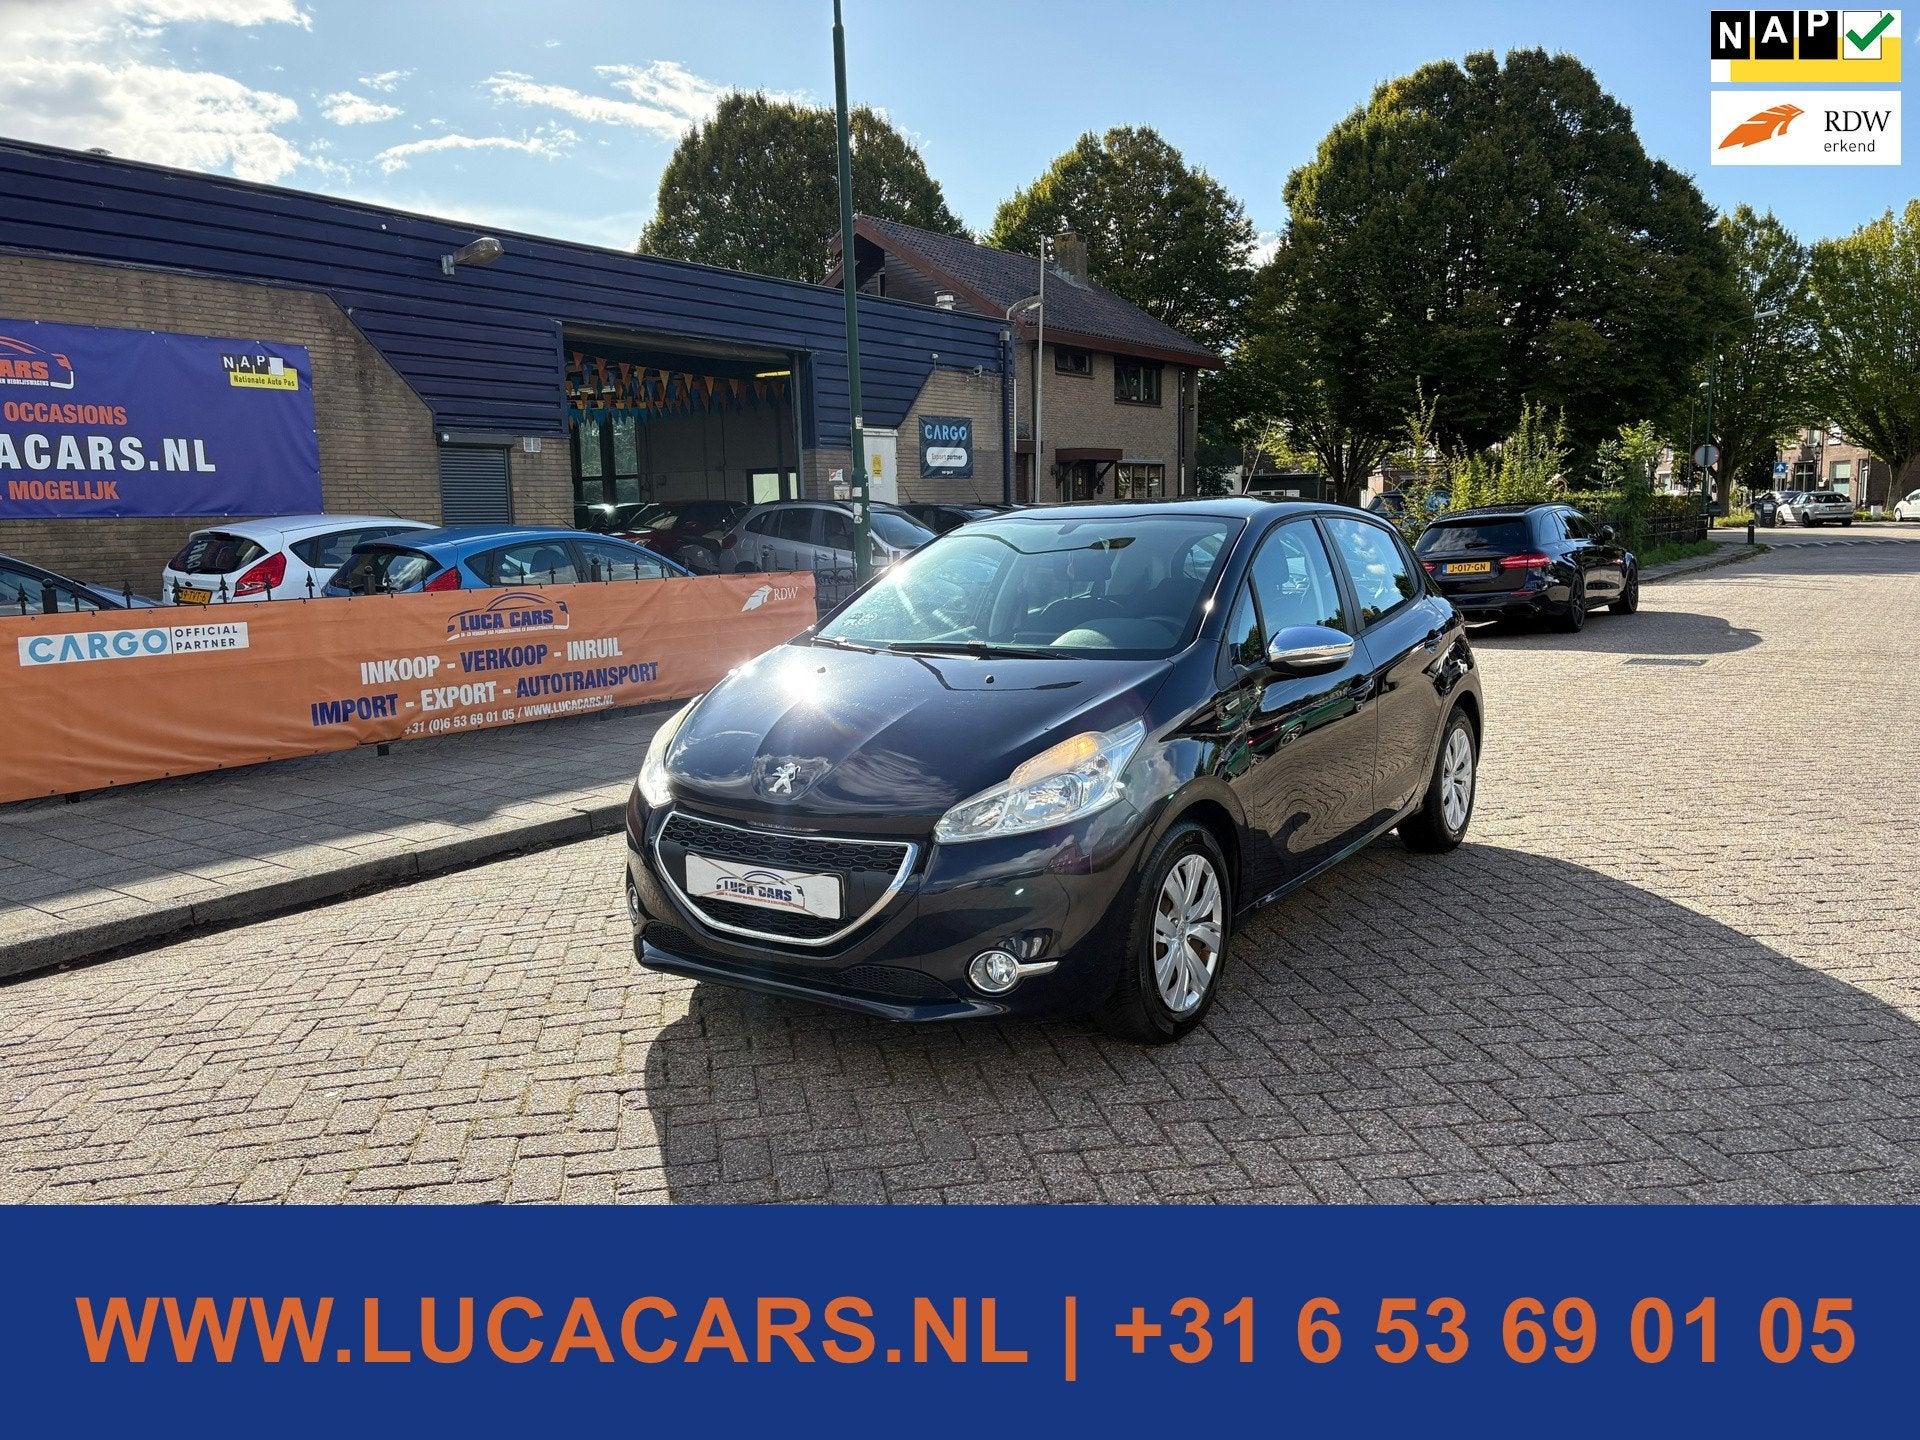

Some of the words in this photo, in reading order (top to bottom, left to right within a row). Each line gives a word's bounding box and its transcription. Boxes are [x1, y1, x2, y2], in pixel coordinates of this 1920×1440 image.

[223, 355, 265, 368] NAP
[233, 375, 266, 385] Nationale
[267, 377, 282, 386] Auto
[283, 378, 295, 387] Pas
[4, 401, 128, 426] OCCASIONS
[925, 424, 967, 440] CARGO
[0, 433, 216, 473] ACARS.NL
[8, 480, 120, 500] MOGELIJK
[1450, 563, 1486, 573] J-017-GN
[773, 586, 799, 601] RDW
[460, 613, 504, 631] LUCA
[509, 609, 554, 627] CARS
[175, 625, 238, 638] OFFICIAL
[28, 629, 168, 663] CARGO
[176, 638, 236, 651] PARTNER
[360, 655, 440, 685] INKOOP
[460, 644, 548, 673] VERKOOP
[567, 637, 623, 661] INRUIL
[311, 693, 398, 726] IMPORT
[421, 681, 497, 711] EXPORT
[516, 661, 659, 698] AUTOTRANSPORT
[404, 721, 426, 735] +31
[428, 718, 450, 733] (0)6
[453, 716, 467, 727] 53
[470, 713, 484, 725] 69
[486, 712, 499, 723] 01
[502, 708, 515, 720] 05
[524, 694, 615, 717] WWW.LUCACARS.NL
[758, 886, 792, 901] CARS
